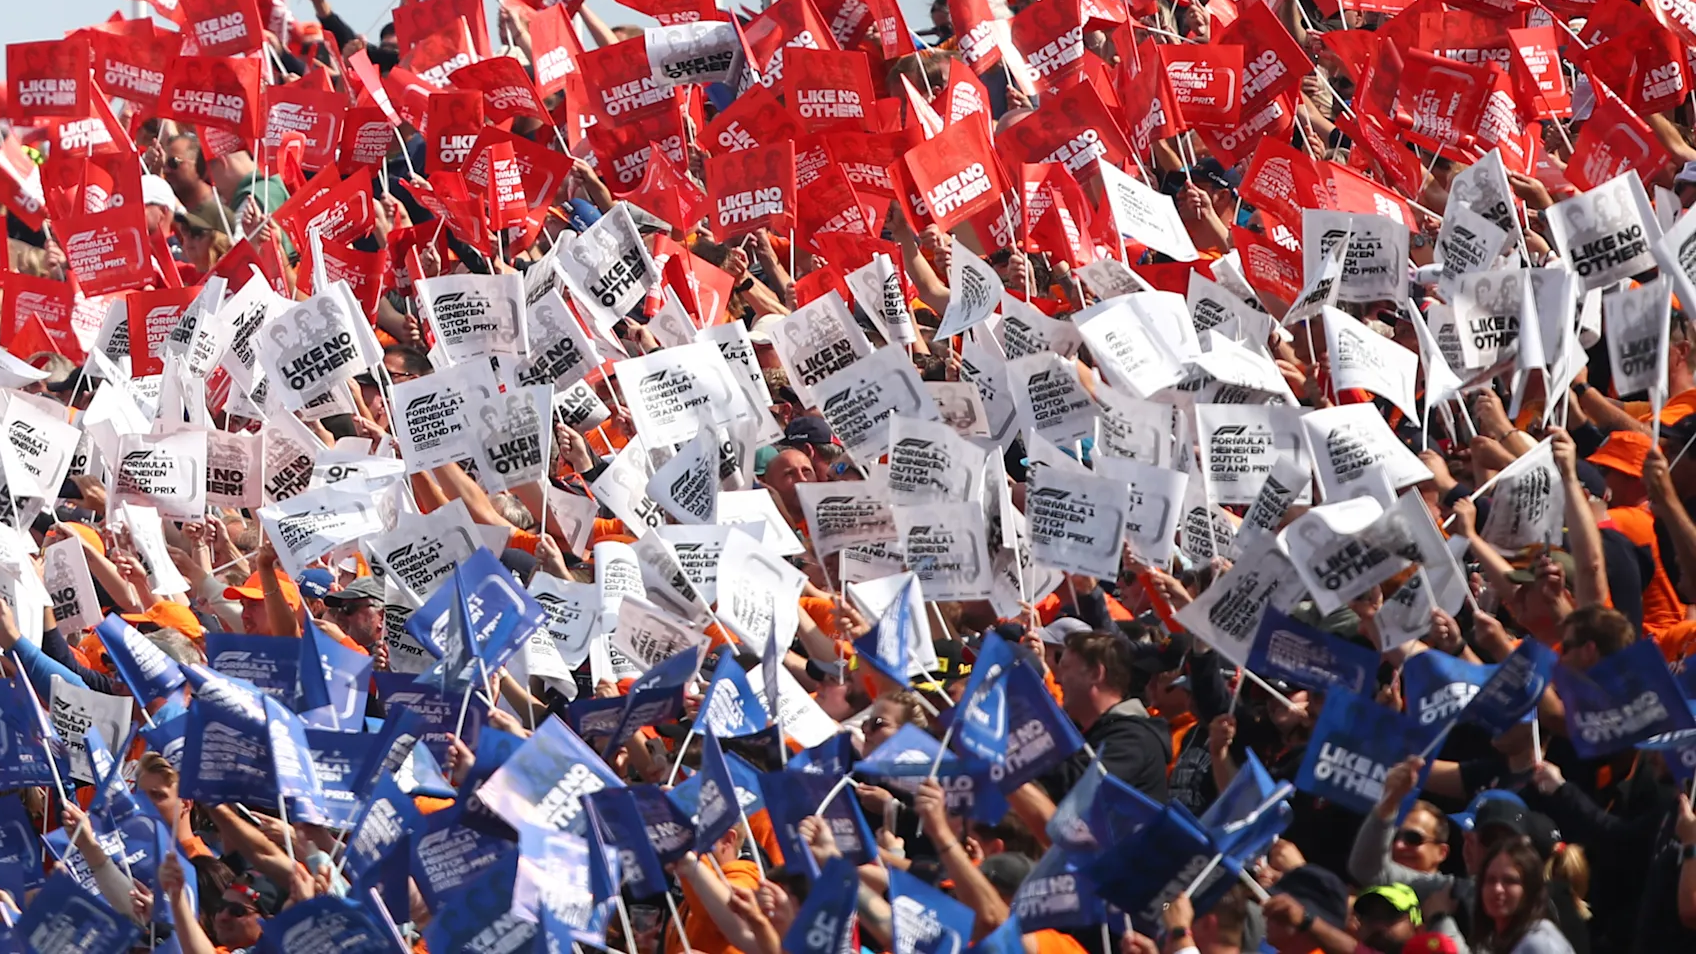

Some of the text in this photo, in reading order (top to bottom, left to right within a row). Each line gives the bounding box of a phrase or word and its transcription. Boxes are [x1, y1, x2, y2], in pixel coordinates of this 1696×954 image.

[220, 12, 244, 27] NO
[1481, 48, 1511, 62] NO
[105, 59, 164, 85] LIKE NO
[665, 57, 701, 74] LIKE
[1651, 62, 1680, 81] NO
[19, 79, 76, 93] LIKE NO
[602, 83, 643, 103] LIKE
[173, 89, 244, 110] LIKE NO
[606, 83, 675, 117] OTHER!
[798, 90, 860, 105] LIKE NO
[1191, 95, 1215, 105] PRIX
[172, 99, 244, 124] OTHER!
[1071, 128, 1098, 151] NO
[927, 162, 985, 205] LIKE NO
[718, 187, 781, 212] LIKE NO
[935, 179, 991, 218] OTHER!
[719, 200, 783, 227] OTHER!
[1570, 225, 1642, 265] LIKE NO
[1578, 243, 1648, 276] OTHER!
[433, 302, 479, 313] FORMULA
[473, 323, 498, 332] PRIX
[1470, 318, 1505, 333] LIKE
[281, 332, 351, 379] LIKE NO
[548, 338, 573, 357] NO
[290, 346, 358, 390] OTHER!
[406, 399, 457, 419] FORMULA
[823, 392, 873, 420] FORMULA
[410, 420, 445, 436] DUTCH
[833, 413, 868, 434] DUTCH
[412, 427, 449, 443] GRAND
[1211, 436, 1273, 445] FORMULA 1
[121, 461, 167, 469] FORMULA
[1211, 456, 1248, 464] DUTCH
[1211, 464, 1249, 473] GRAND
[215, 469, 244, 481] NO
[264, 469, 295, 495] LIKE
[154, 486, 177, 494] PRIX
[1067, 533, 1094, 545] PRIX
[1315, 544, 1356, 578] LIKE
[958, 663, 972, 675] 1st
[1319, 742, 1373, 772] LIKE
